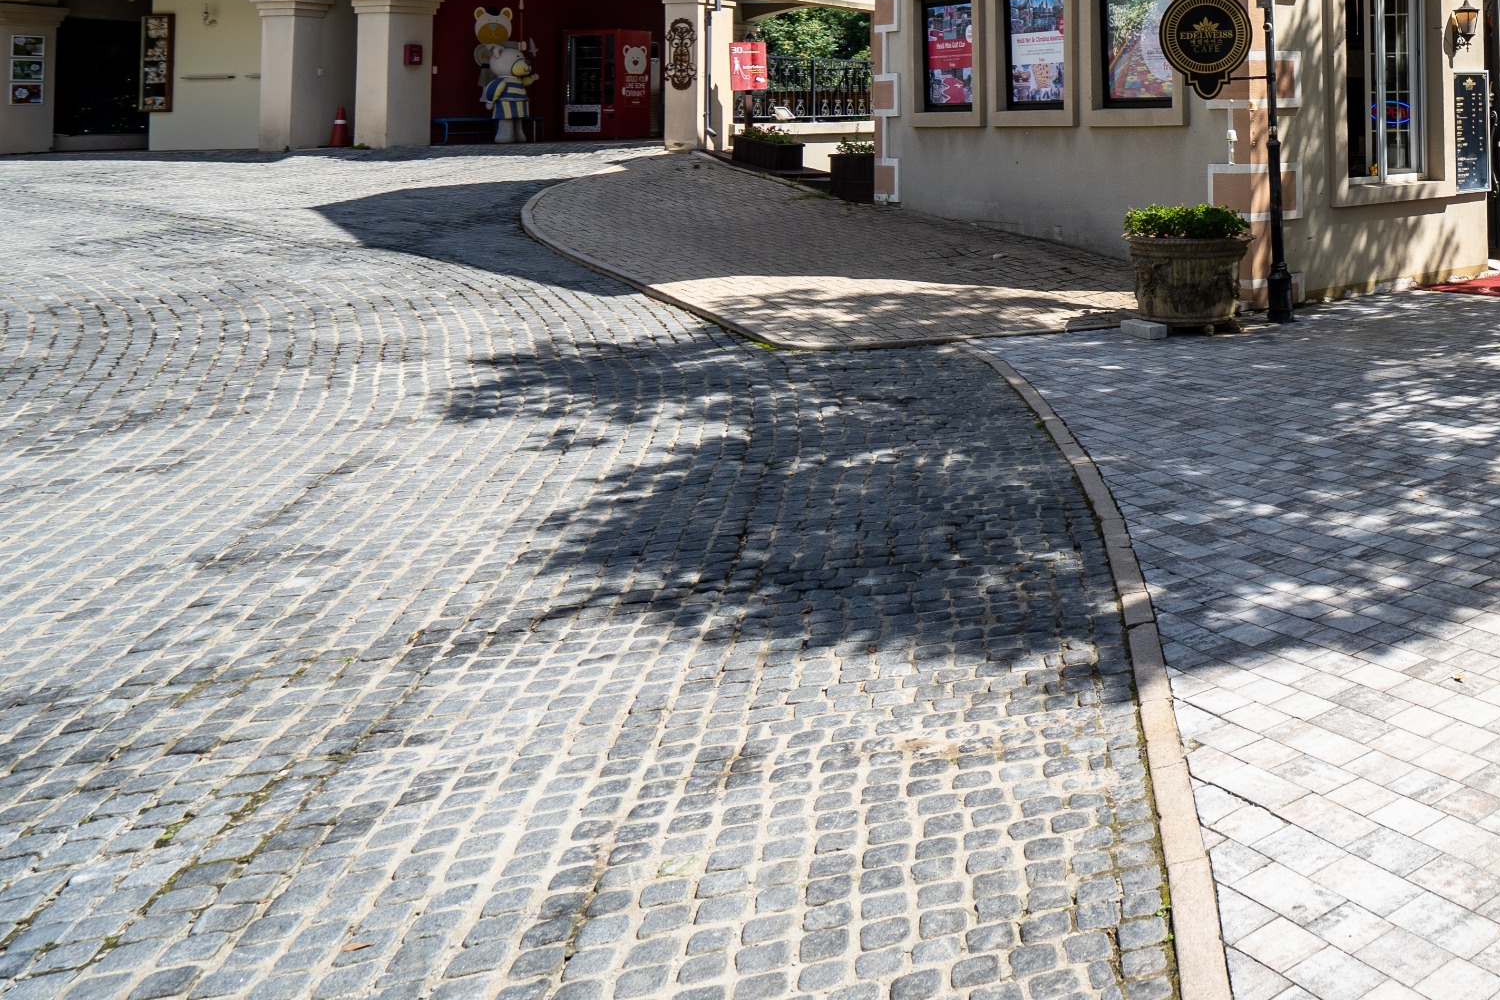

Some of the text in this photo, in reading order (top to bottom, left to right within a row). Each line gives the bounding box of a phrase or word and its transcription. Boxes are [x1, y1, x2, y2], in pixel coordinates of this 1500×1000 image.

[1180, 30, 1233, 40] EDELWEISS
[1193, 45, 1221, 53] CAFE
[625, 89, 646, 98] DRINK?
